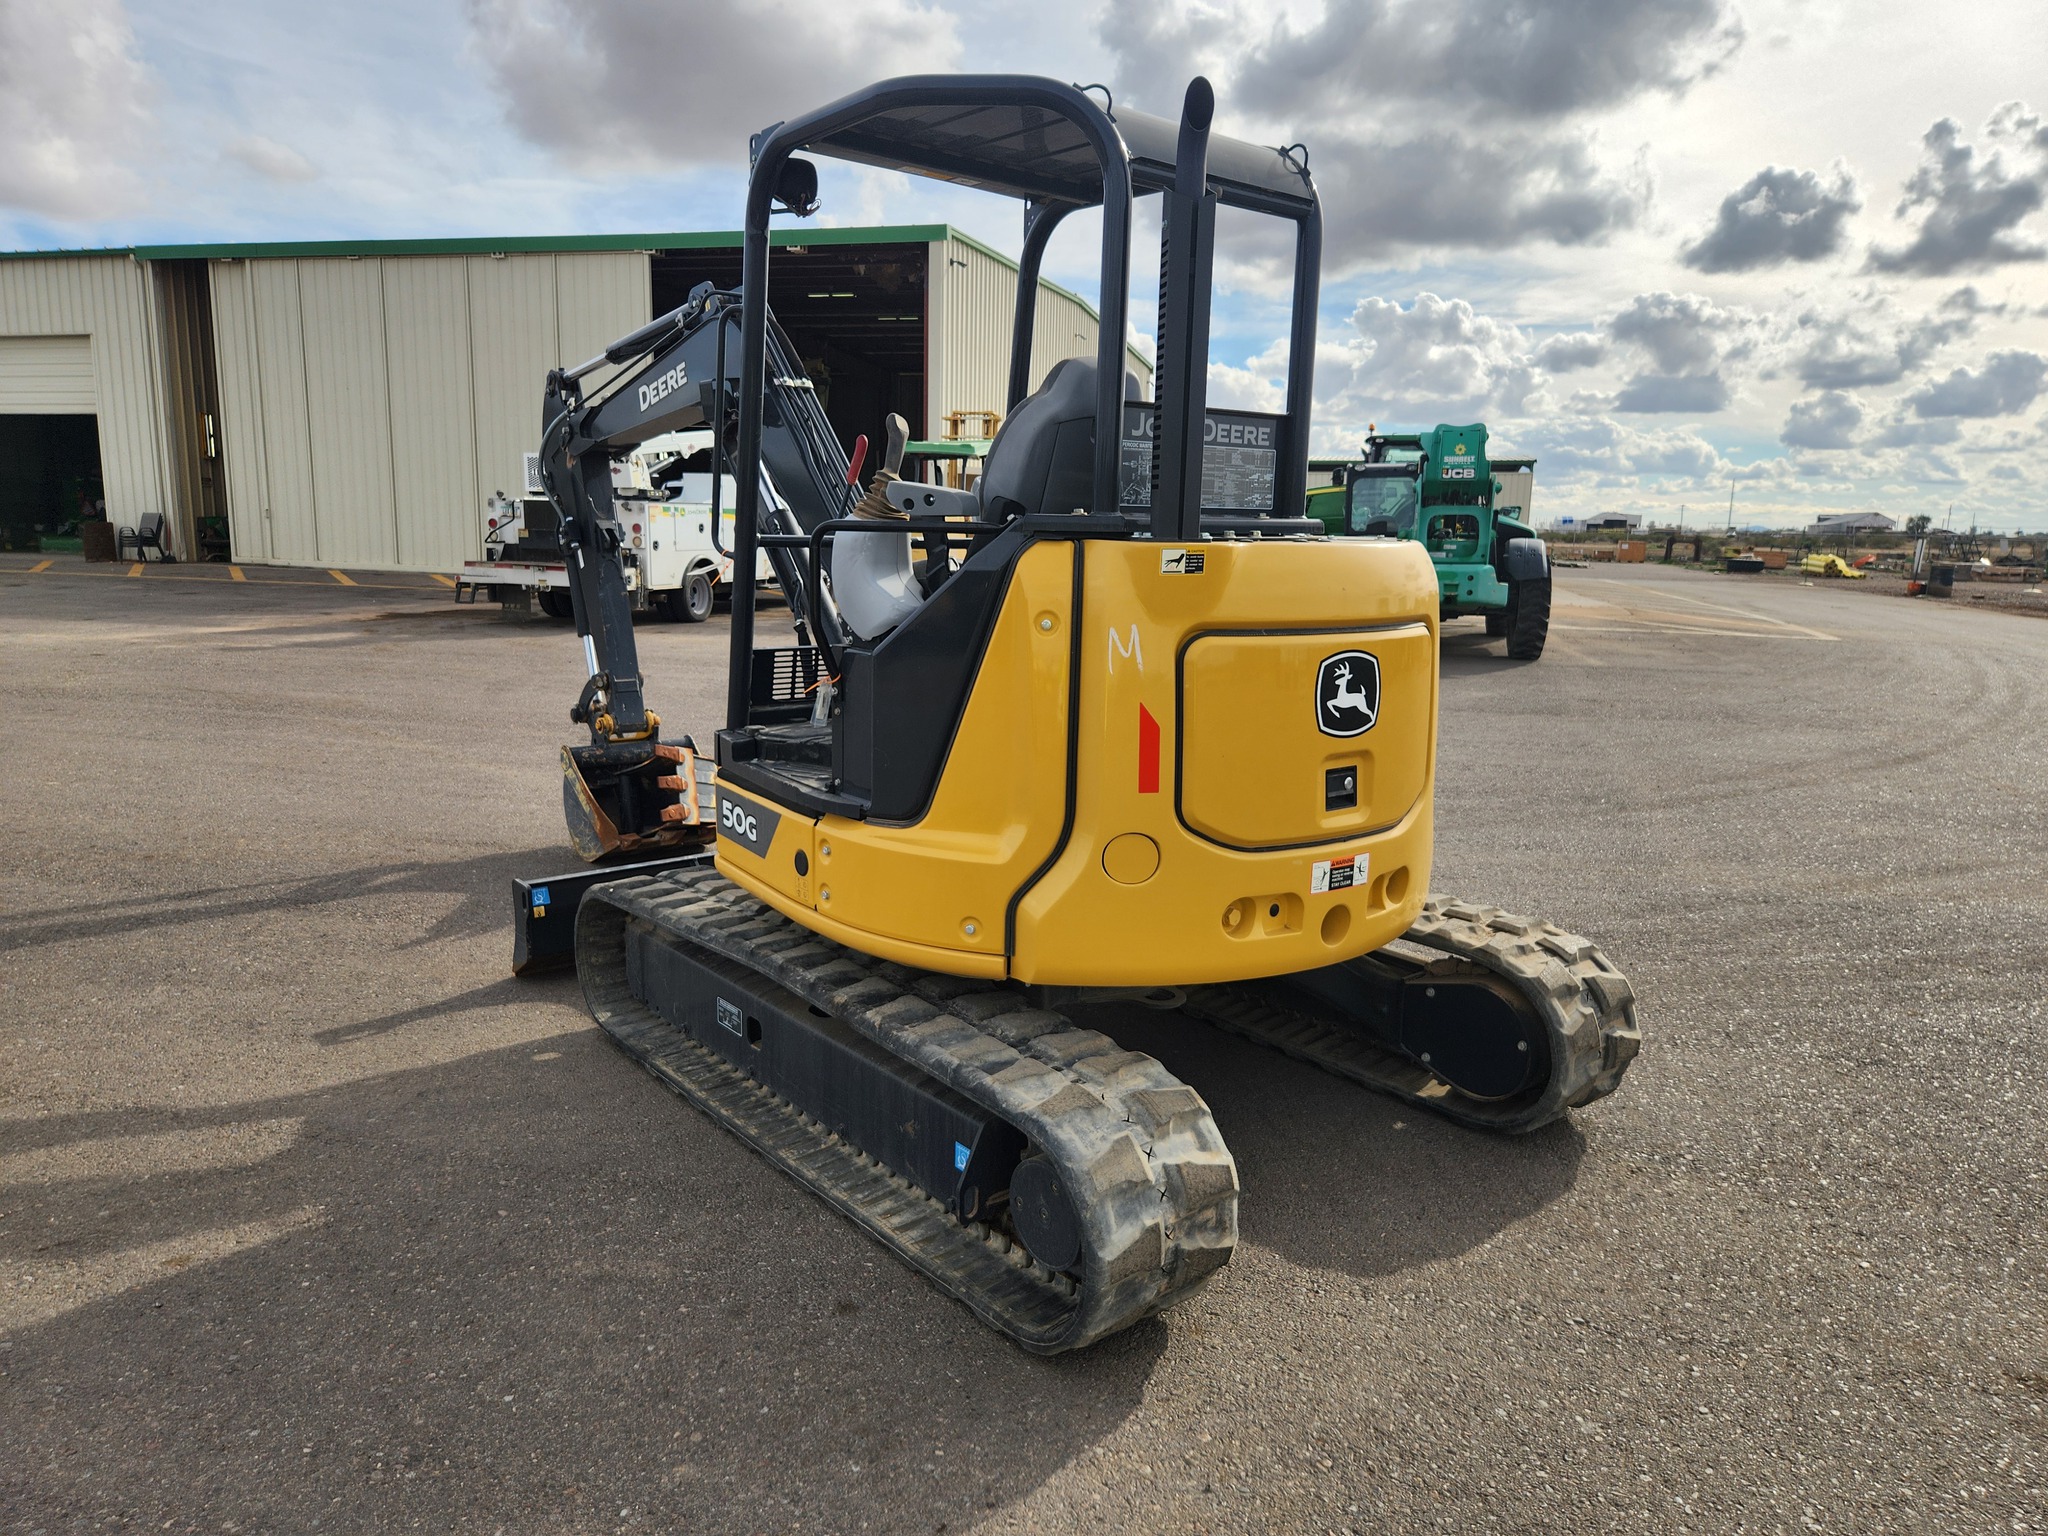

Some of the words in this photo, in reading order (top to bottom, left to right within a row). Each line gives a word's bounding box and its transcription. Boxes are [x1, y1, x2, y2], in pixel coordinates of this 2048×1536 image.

[639, 361, 688, 412] DEERE
[1203, 418, 1271, 446] DEERE
[1442, 468, 1475, 478] JCB
[1108, 624, 1144, 675] M
[722, 798, 757, 842] 50G
